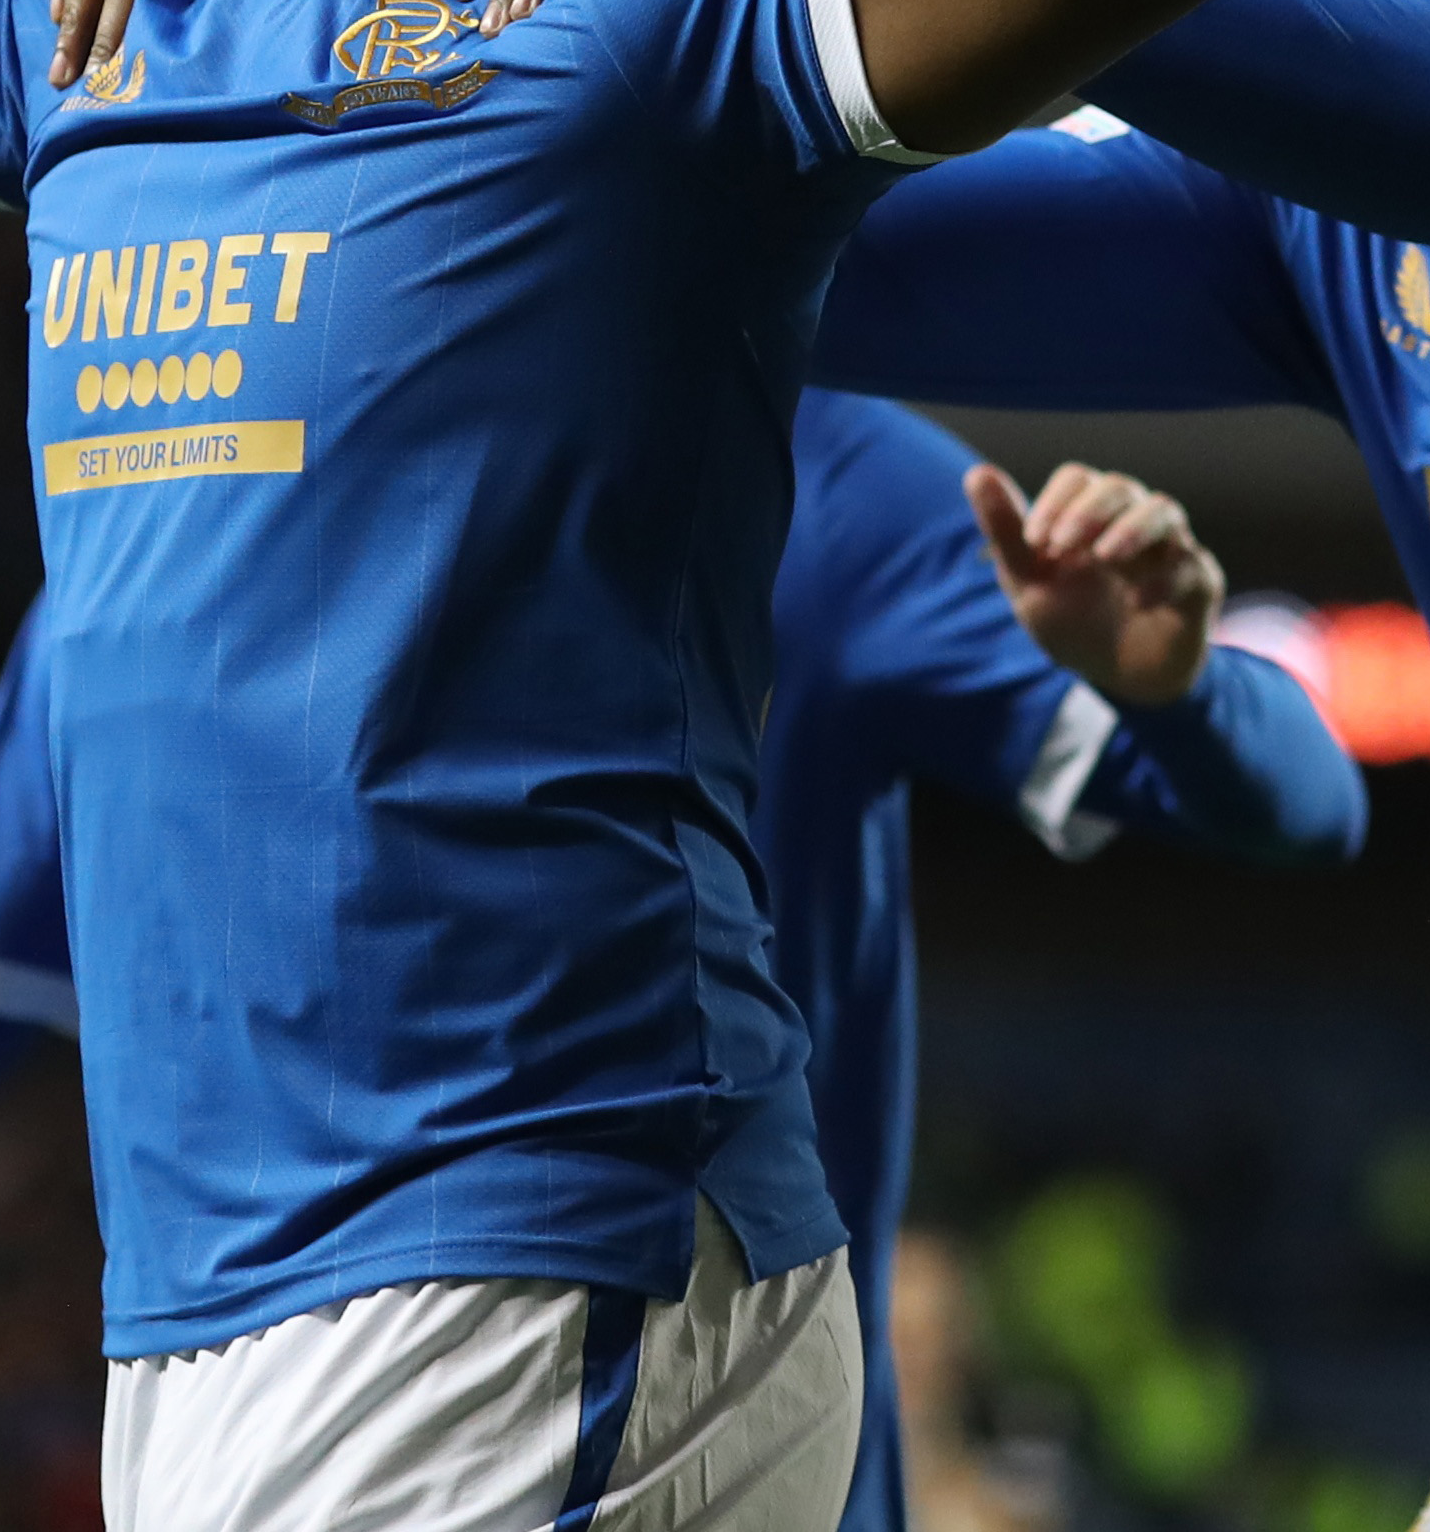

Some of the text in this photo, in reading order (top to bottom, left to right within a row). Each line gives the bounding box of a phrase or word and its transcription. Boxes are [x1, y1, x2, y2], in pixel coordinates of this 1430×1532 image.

[43, 232, 330, 349] UNIBET
[79, 434, 238, 478] SET YOUR LIMITS
